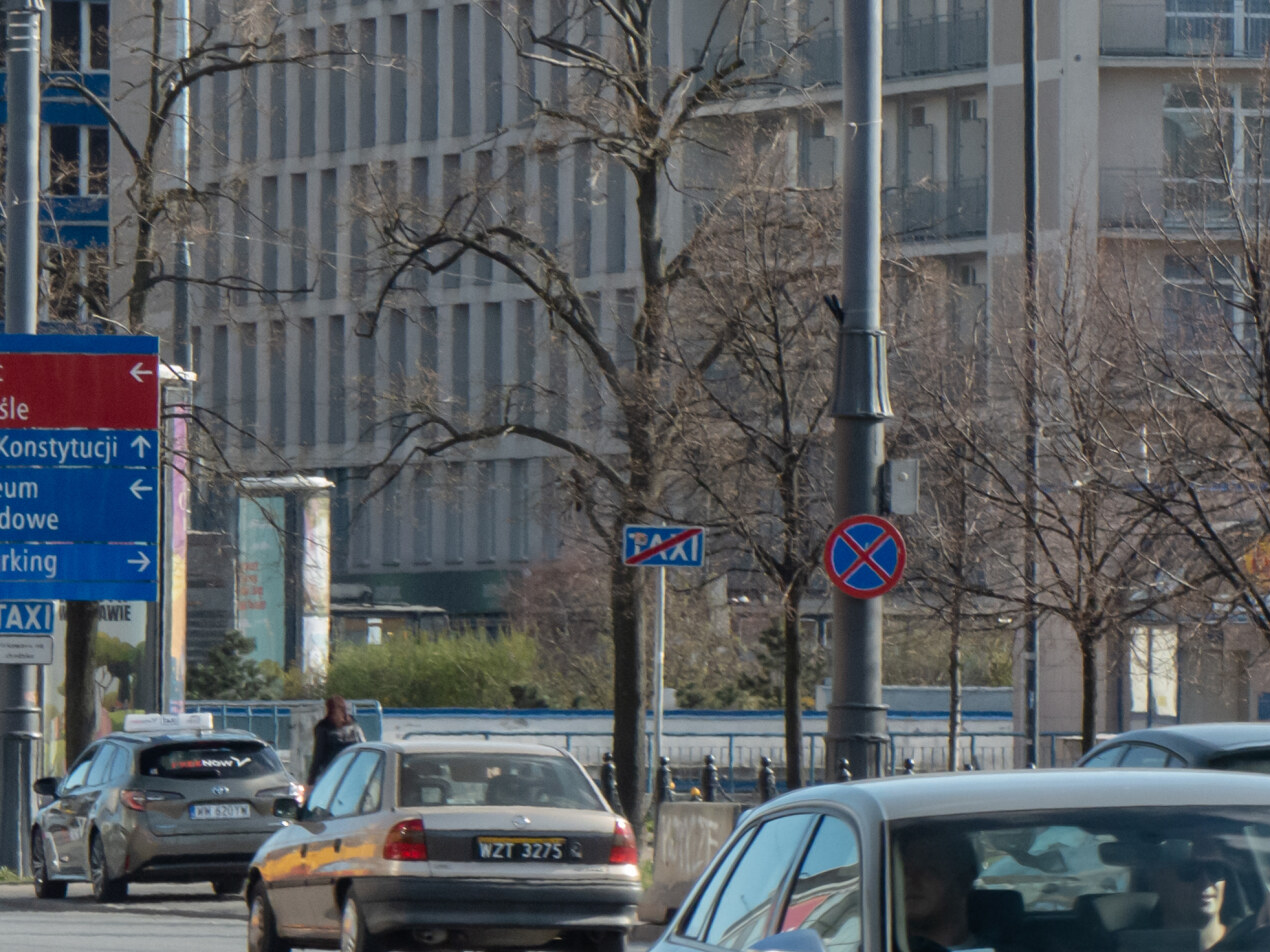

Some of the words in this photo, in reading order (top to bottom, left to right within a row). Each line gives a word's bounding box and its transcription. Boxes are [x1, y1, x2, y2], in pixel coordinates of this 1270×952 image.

[628, 532, 698, 561] TAXI
[480, 842, 514, 859] WZT
[521, 842, 563, 859] 3275
